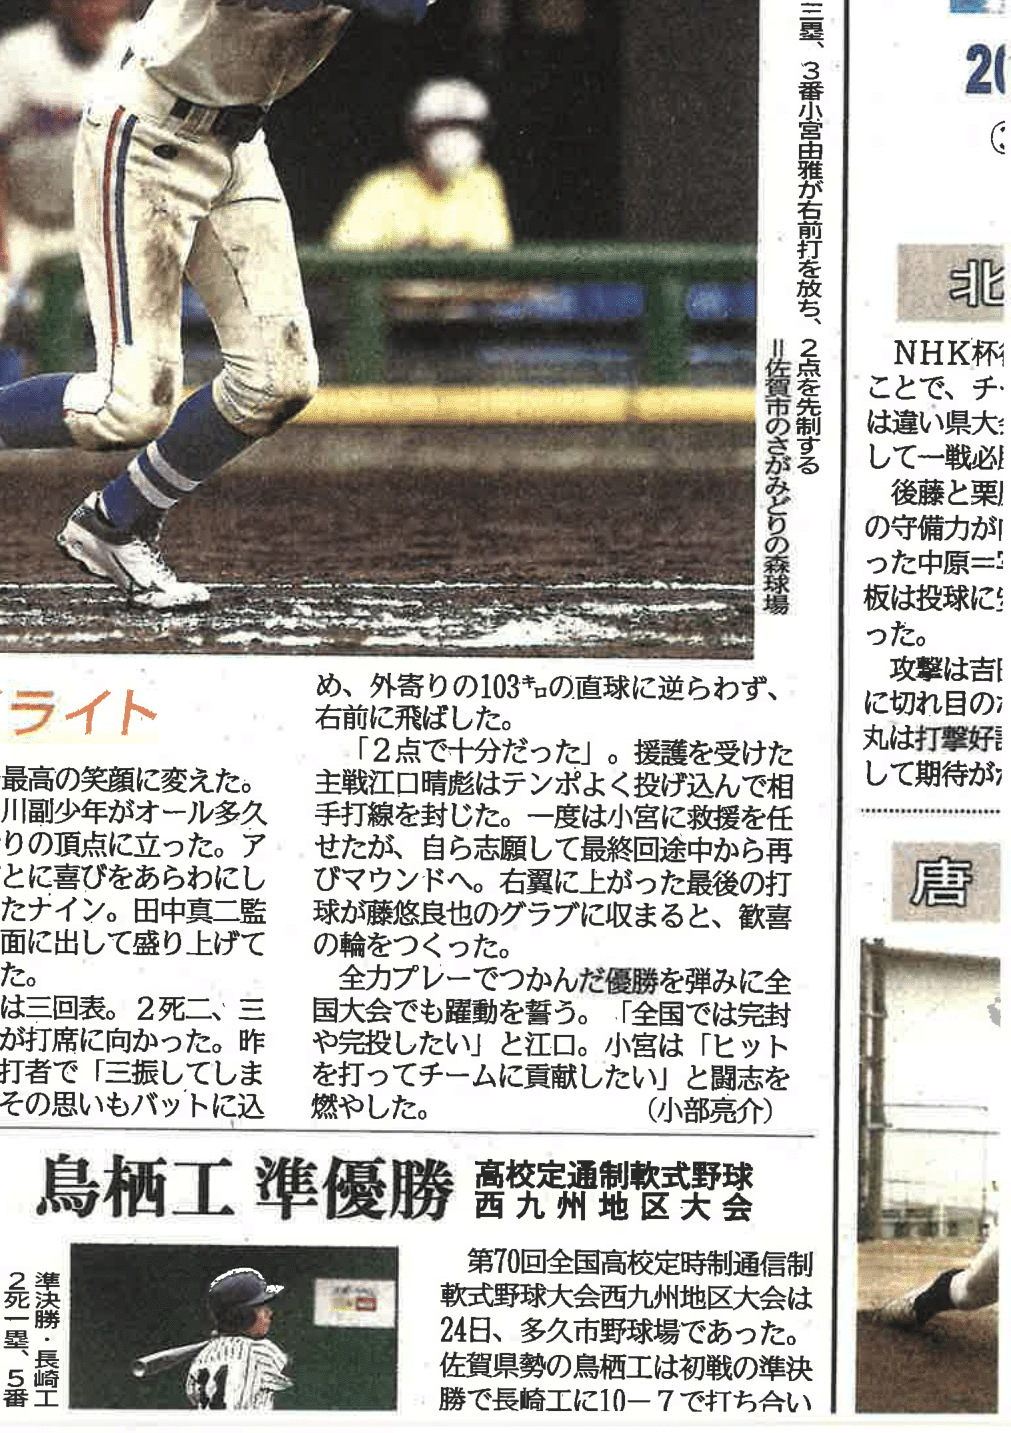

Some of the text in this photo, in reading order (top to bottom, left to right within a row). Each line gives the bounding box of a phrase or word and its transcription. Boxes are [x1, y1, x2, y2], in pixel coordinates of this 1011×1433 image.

[950, 260, 1004, 307] 北
[316, 704, 510, 730] 右前に飛ばした。
[360, 736, 793, 766] 「2点で十分だった」。援護を受けた
[315, 769, 793, 799] 主戦江口晴彪はテンポよく投げ込んで相
[315, 801, 793, 831] 手打線を封じた。一度は小宮に救援を任
[315, 834, 793, 864] せたが、自ら志願して最終回途中から再
[314, 866, 792, 897] びマウンドへ。右翼に上がった最後の打
[910, 856, 972, 907] 唐
[313, 899, 792, 930] 球が藤悠良也のグラブに収まると、歓喜
[314, 932, 508, 958] の輪をつくった。
[339, 964, 791, 994] 全力プレーでつかんだ優勝を弾みに全
[314, 997, 791, 1028] 国大会でも躍動を誓う。「全国では完封
[313, 1029, 787, 1058] や完投したい」と江口。小宮は「ヒット
[313, 1061, 789, 1091] を打ってチームに貢献したい」と闘志を
[311, 1094, 772, 1124] 燃やした。 （小部亮介）
[36, 1155, 454, 1222] 鳥栖工 準優勝
[475, 1159, 753, 1190] 高校定通制軟式野球
[475, 1190, 752, 1221] 西九州地区大会
[468, 1248, 813, 1277] 第70回全国高校定時制通信制
[441, 1282, 812, 1310] 軟式野球大会西九州地区大会は
[34, 1272, 60, 1406] 準決勝・長崎工
[441, 1316, 796, 1345] 24日、多久市野球場であった。
[440, 1352, 813, 1381] 佐賀県勢の鳥栖工は初戦の準決
